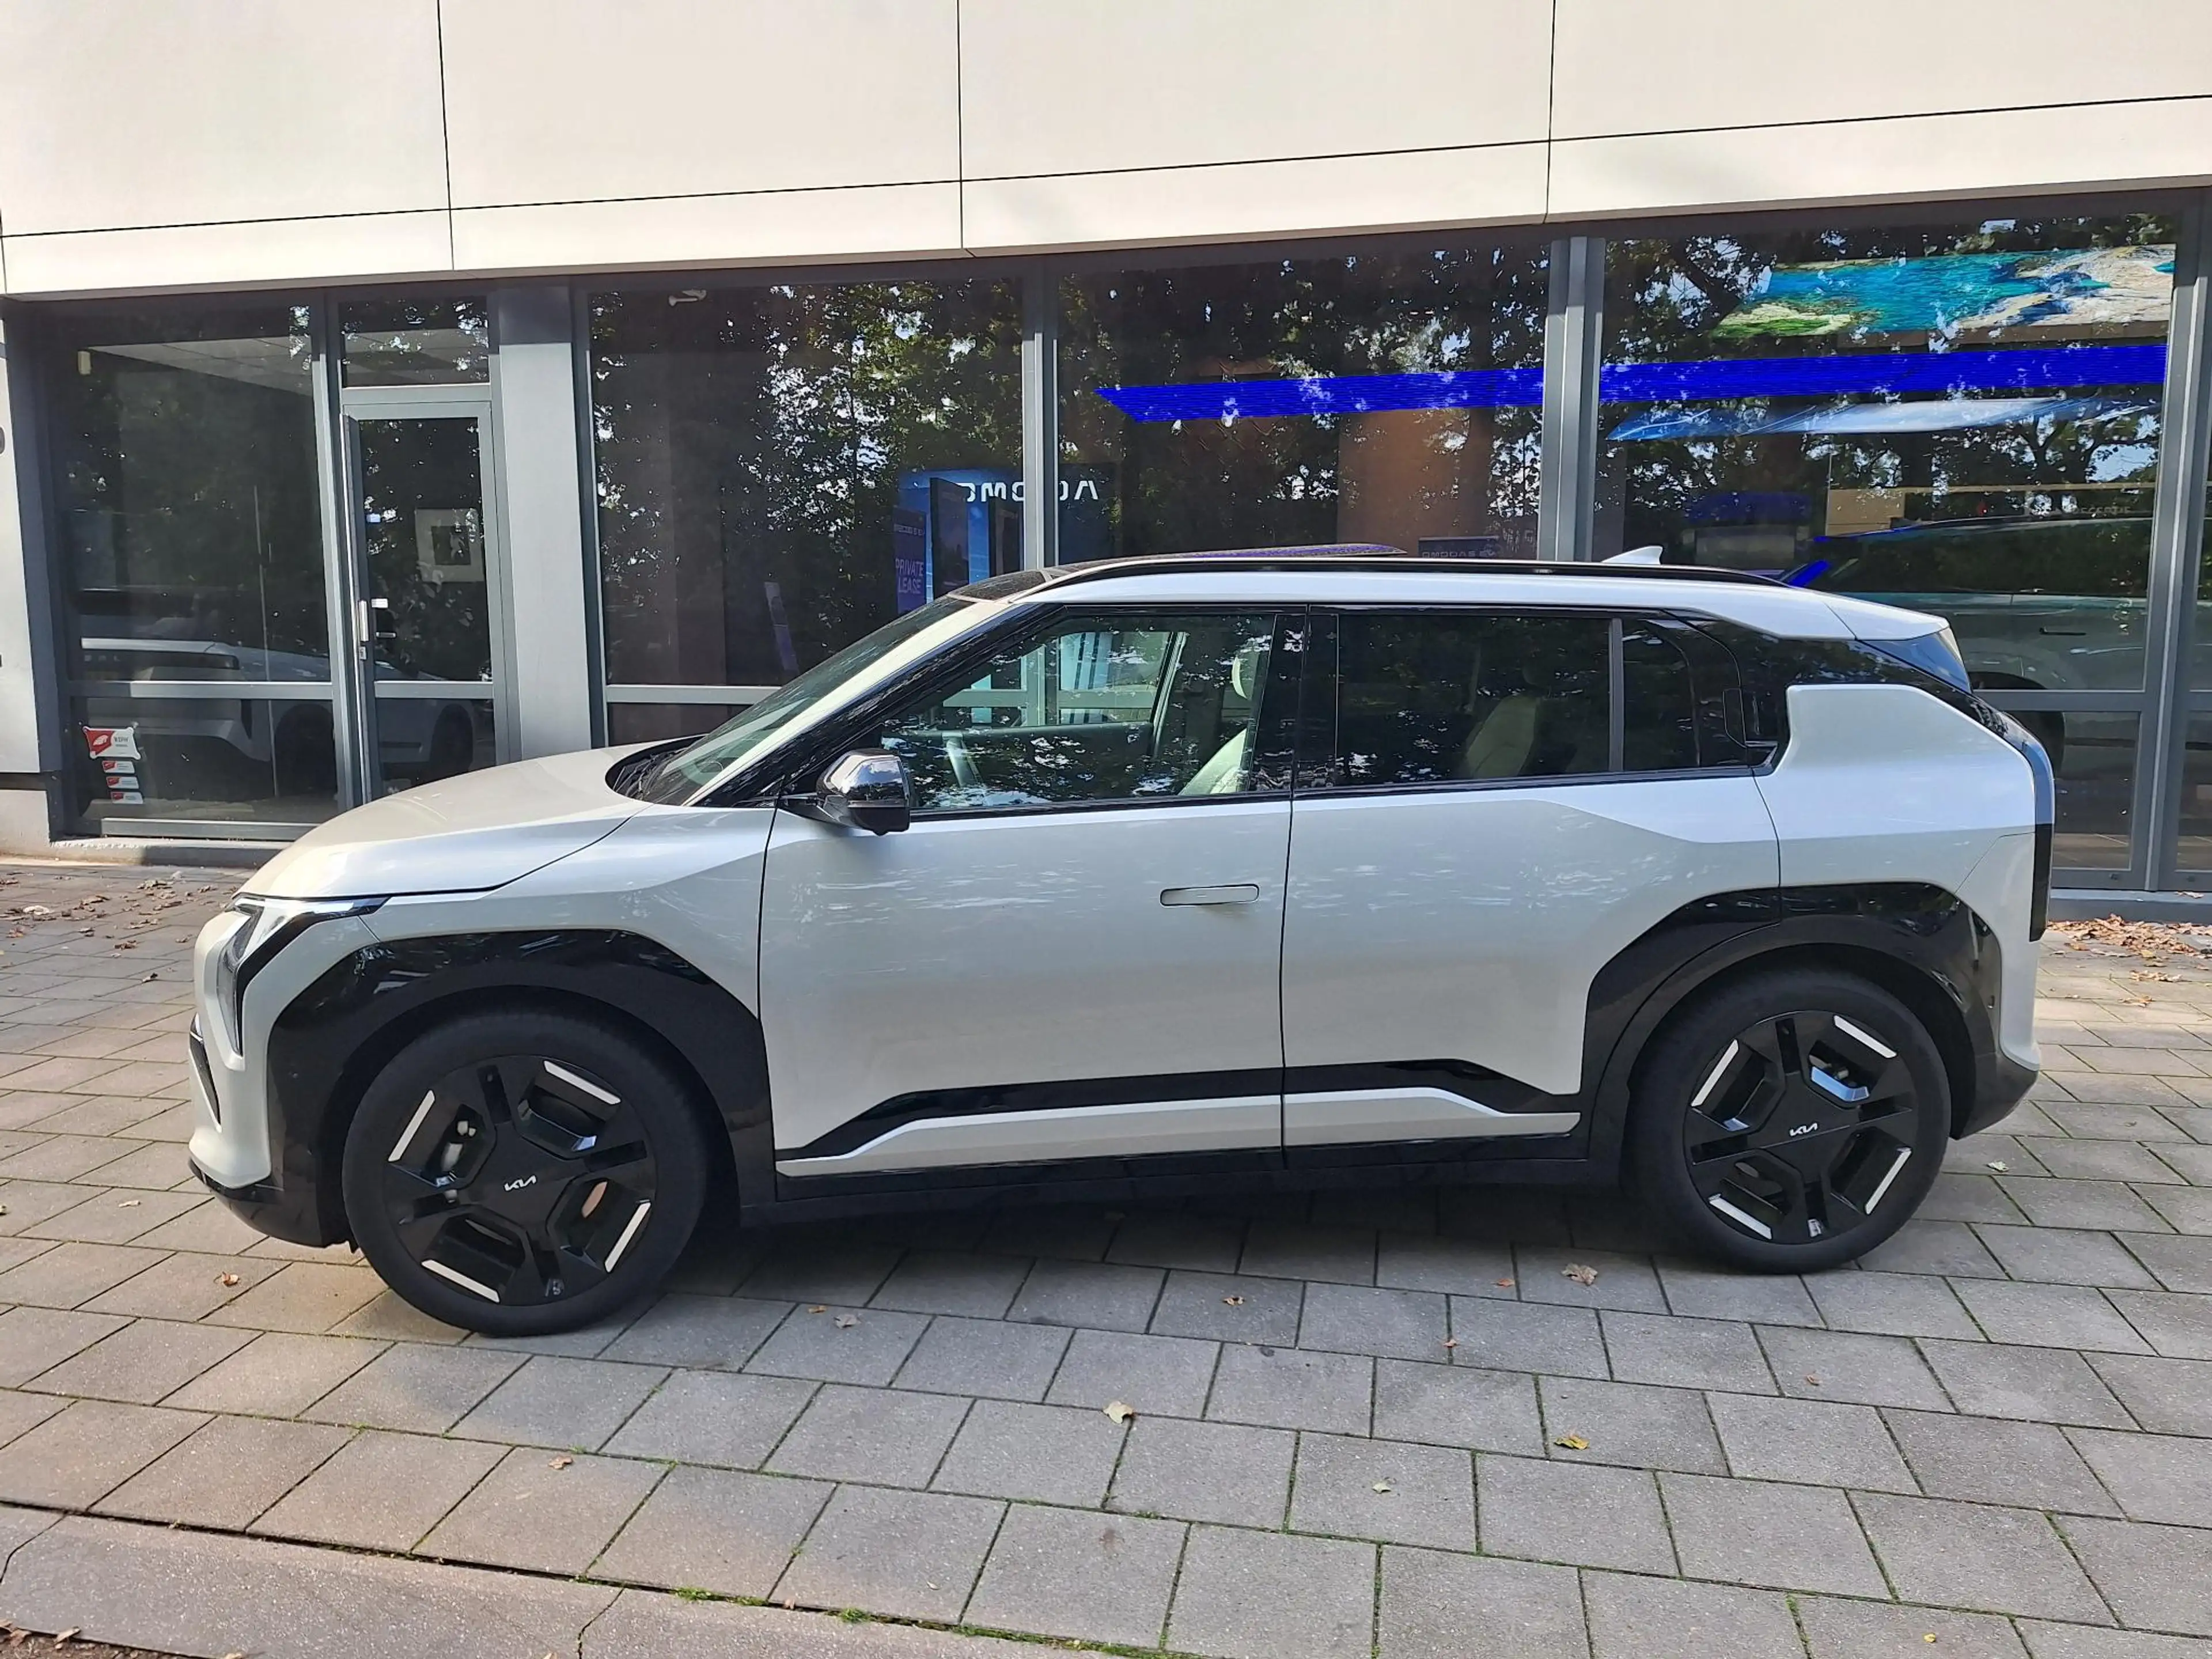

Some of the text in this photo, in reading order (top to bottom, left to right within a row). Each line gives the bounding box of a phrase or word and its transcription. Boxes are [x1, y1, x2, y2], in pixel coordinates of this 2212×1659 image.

[895, 558, 924, 577] PRIVATE
[898, 577, 922, 594] LEASE
[1789, 1122, 1818, 1137] KIA
[504, 1175, 537, 1191] KIA
